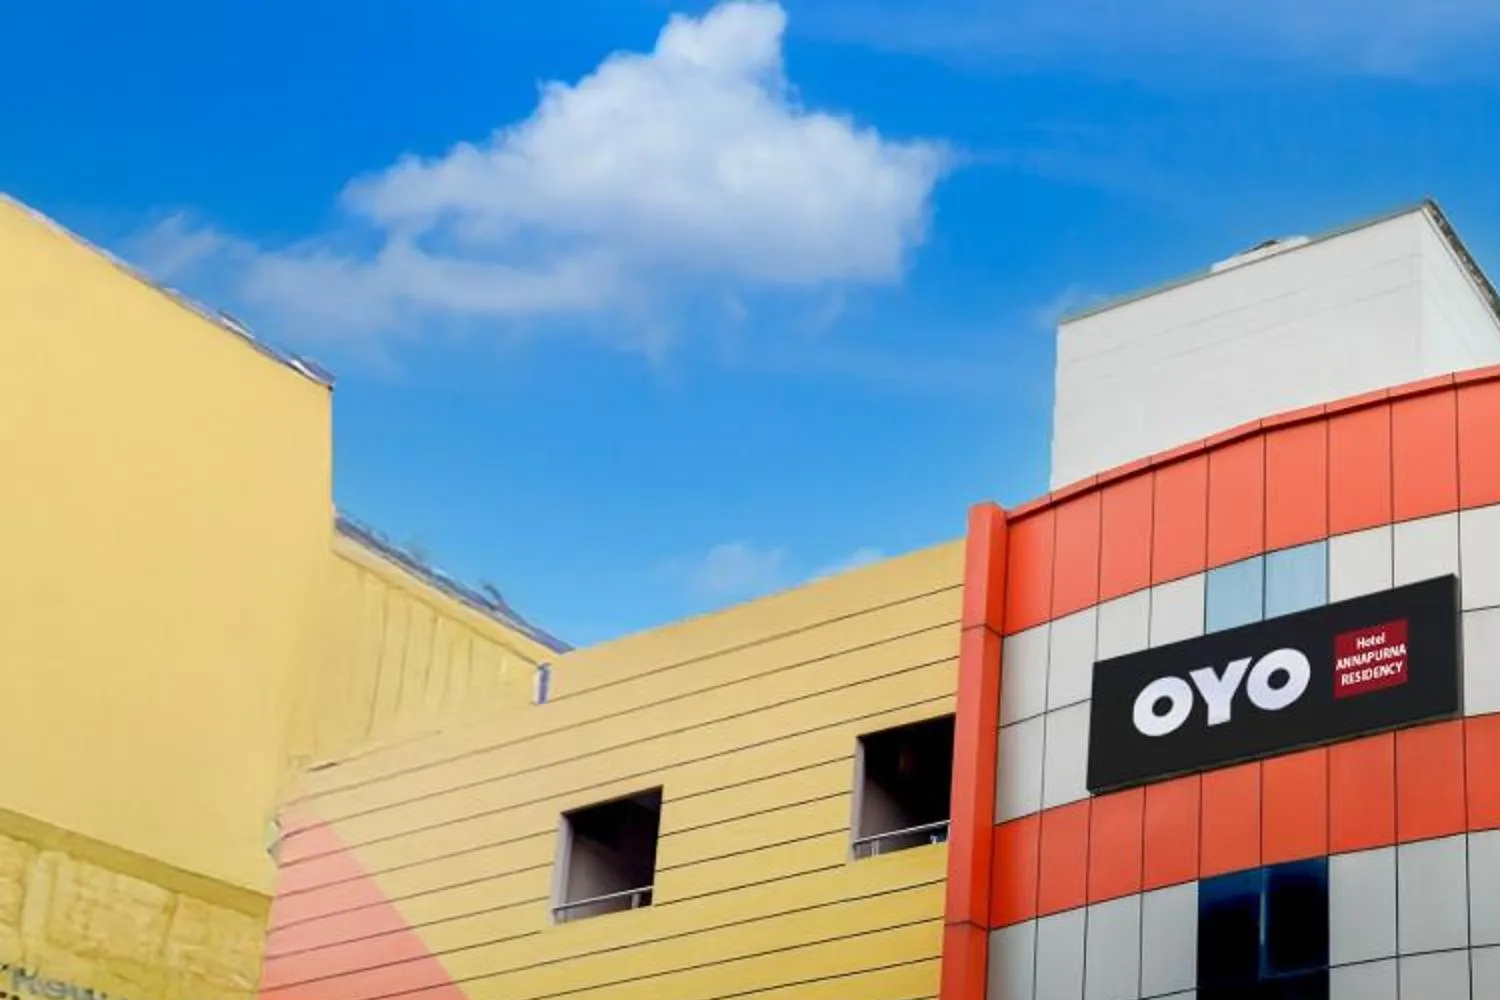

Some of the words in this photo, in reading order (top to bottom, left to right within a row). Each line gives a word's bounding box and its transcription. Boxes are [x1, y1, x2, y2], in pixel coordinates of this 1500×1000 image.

[1356, 631, 1386, 650] Hotel
[1335, 643, 1407, 671] ANNAPURNA
[1341, 660, 1403, 687] RESIDENCY
[1133, 648, 1311, 737] OYO
